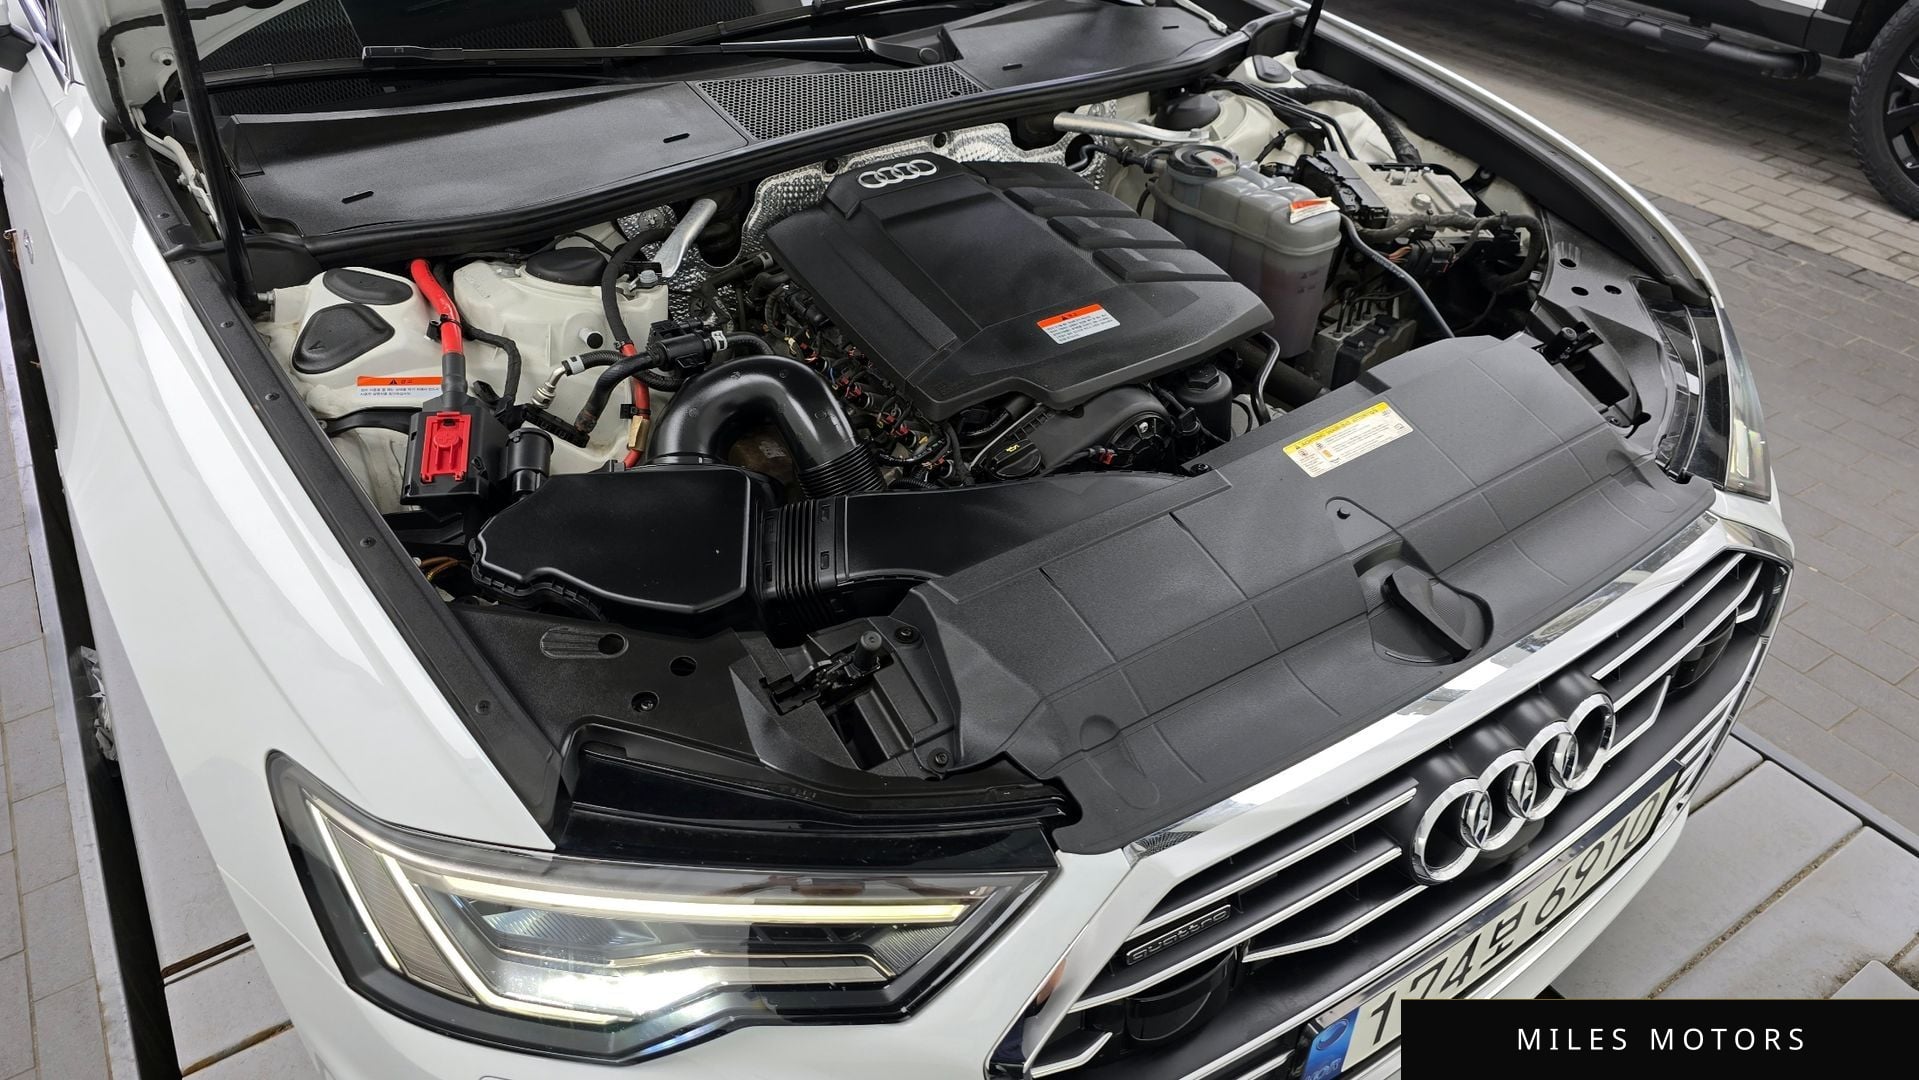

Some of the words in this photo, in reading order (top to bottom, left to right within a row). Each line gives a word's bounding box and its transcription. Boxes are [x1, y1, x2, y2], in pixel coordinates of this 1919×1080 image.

[1131, 909, 1231, 961] quattro
[1371, 901, 1528, 1046] 174보
[1534, 791, 1661, 926] 6910
